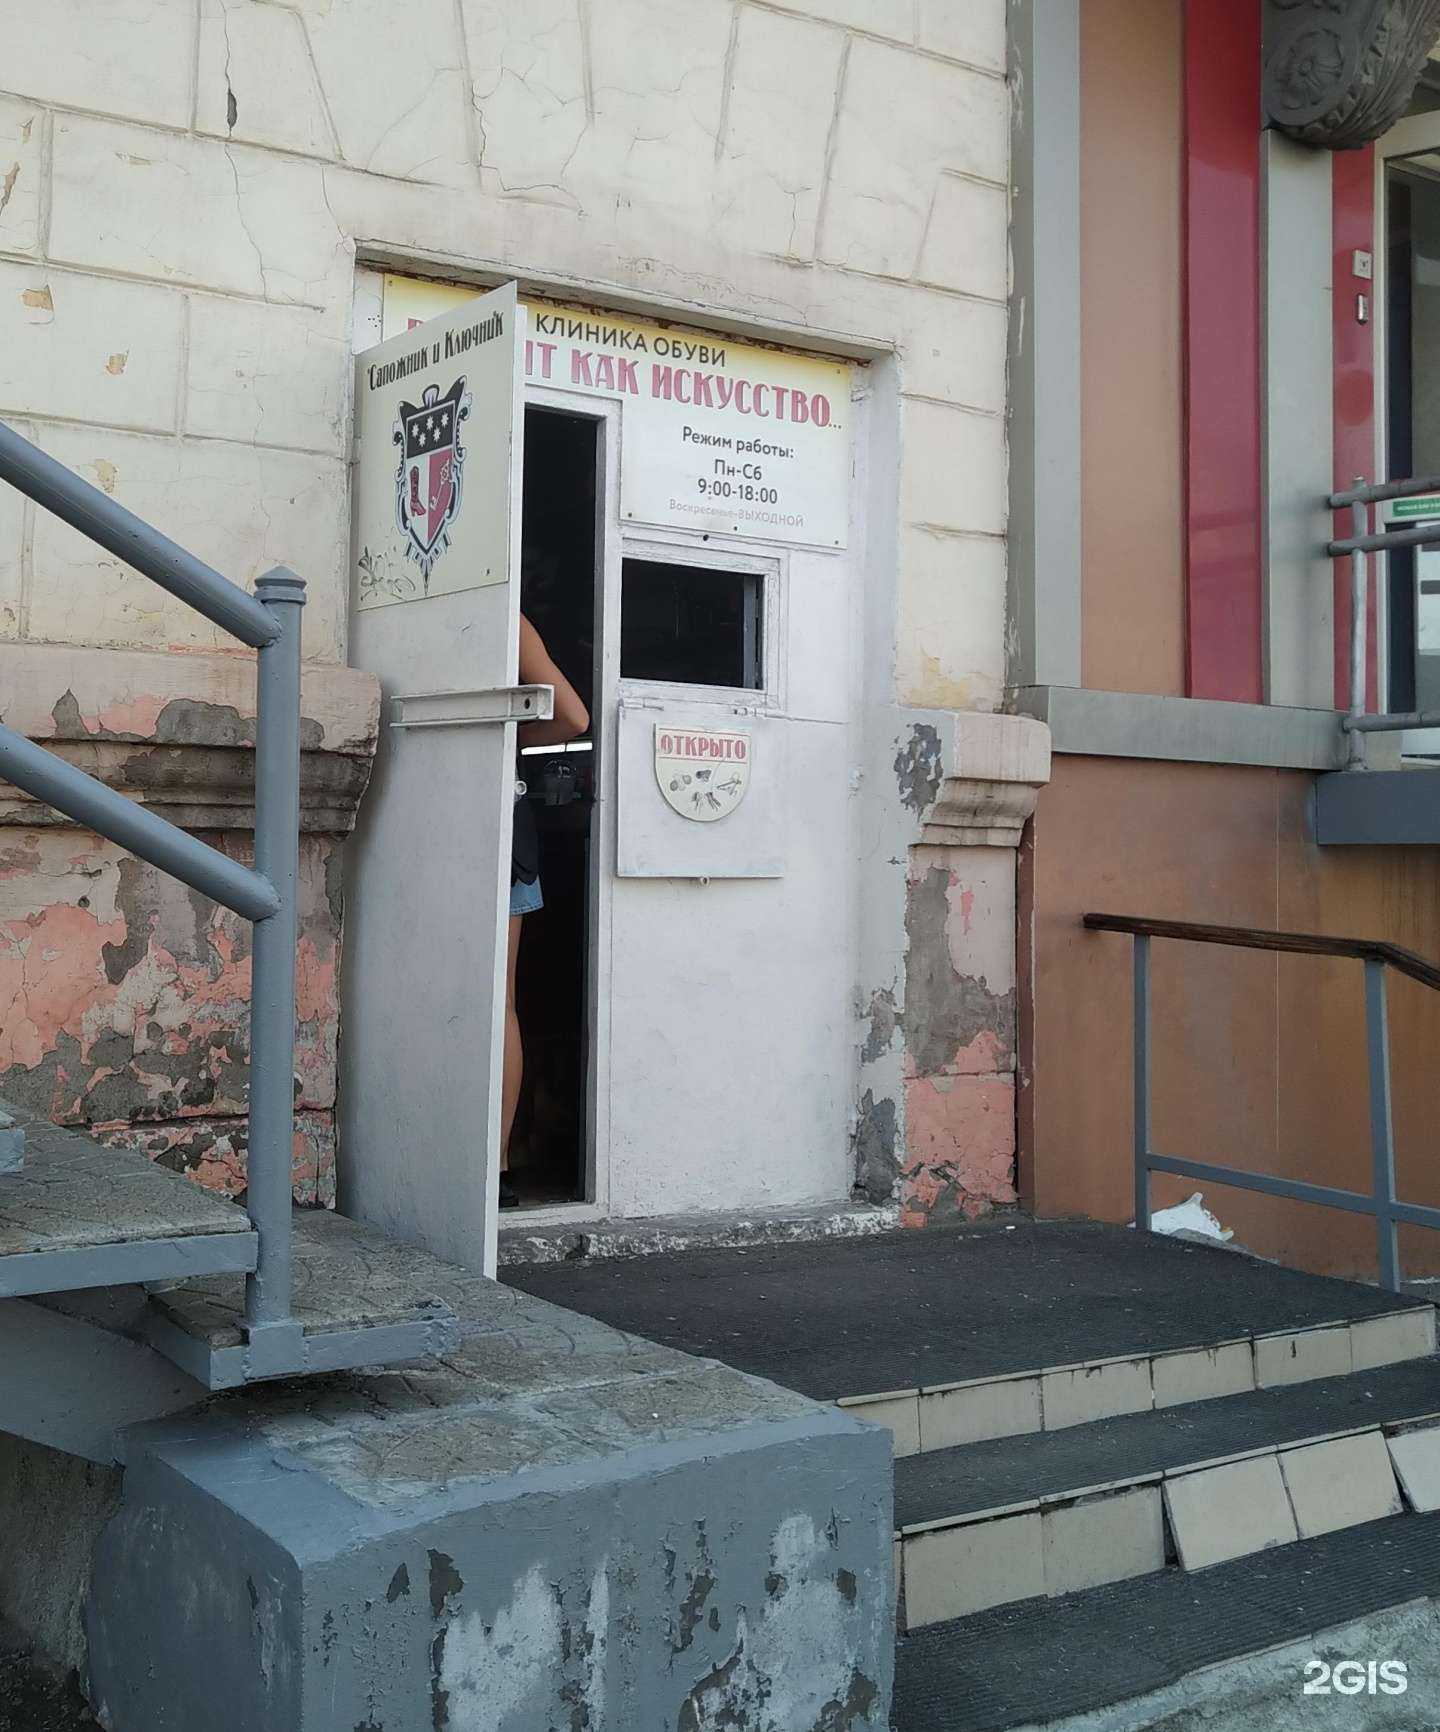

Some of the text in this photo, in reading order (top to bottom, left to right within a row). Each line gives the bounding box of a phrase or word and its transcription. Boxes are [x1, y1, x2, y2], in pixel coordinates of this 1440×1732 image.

[536, 313, 726, 367] КЛИНИКА ОБУВИ
[571, 349, 640, 395] КАК
[682, 426, 794, 458] Режим работы:
[714, 459, 762, 480] Пн-Сб
[698, 478, 778, 504] 9:00-18:00
[660, 734, 747, 759] ОТКРЫТО
